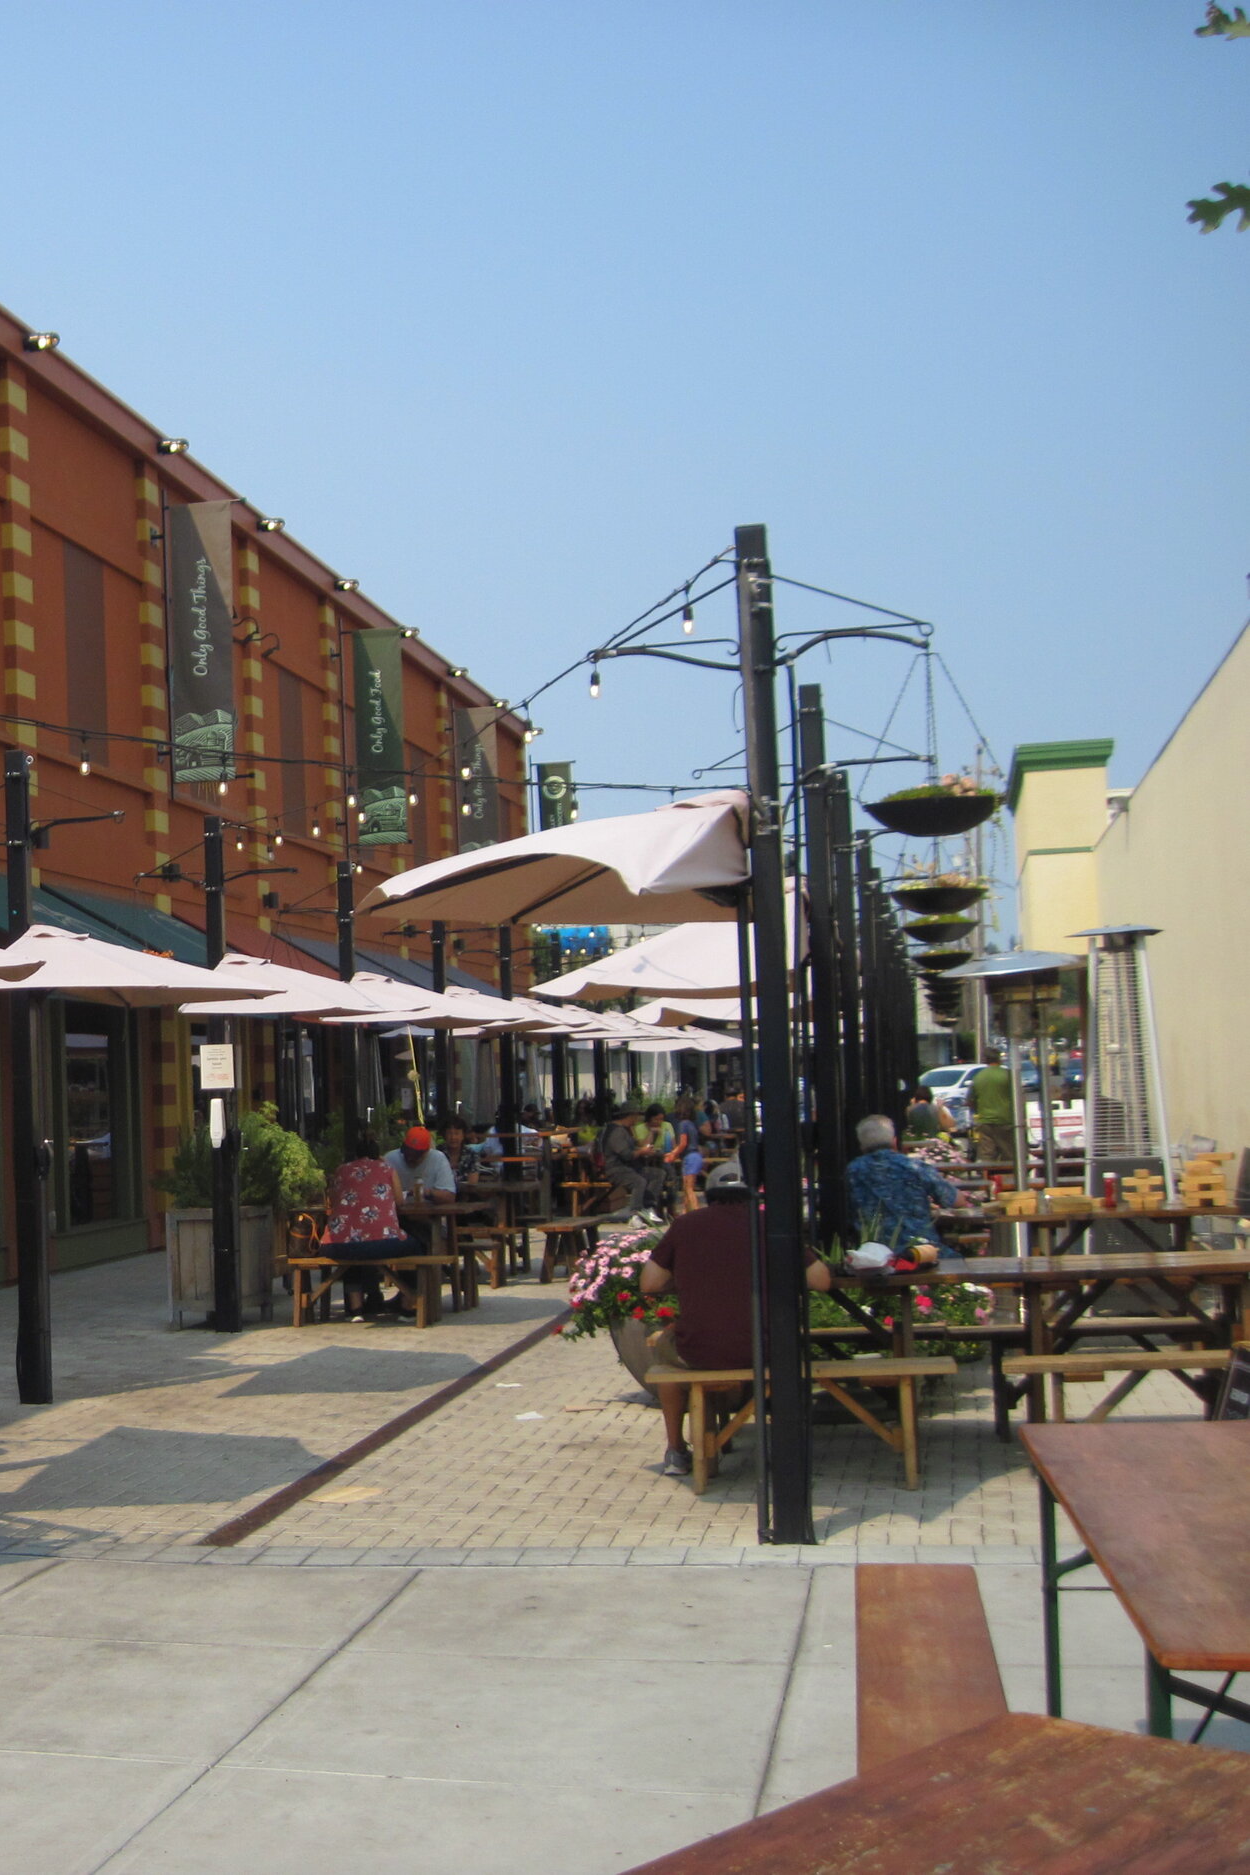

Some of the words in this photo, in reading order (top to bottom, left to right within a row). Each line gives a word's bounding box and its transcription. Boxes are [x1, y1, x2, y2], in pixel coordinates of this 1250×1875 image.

[190, 555, 212, 603] Things
[191, 605, 212, 640] Good
[191, 643, 214, 676] Only
[369, 669, 382, 697] Food
[369, 698, 386, 725] Good
[370, 727, 388, 753] Only
